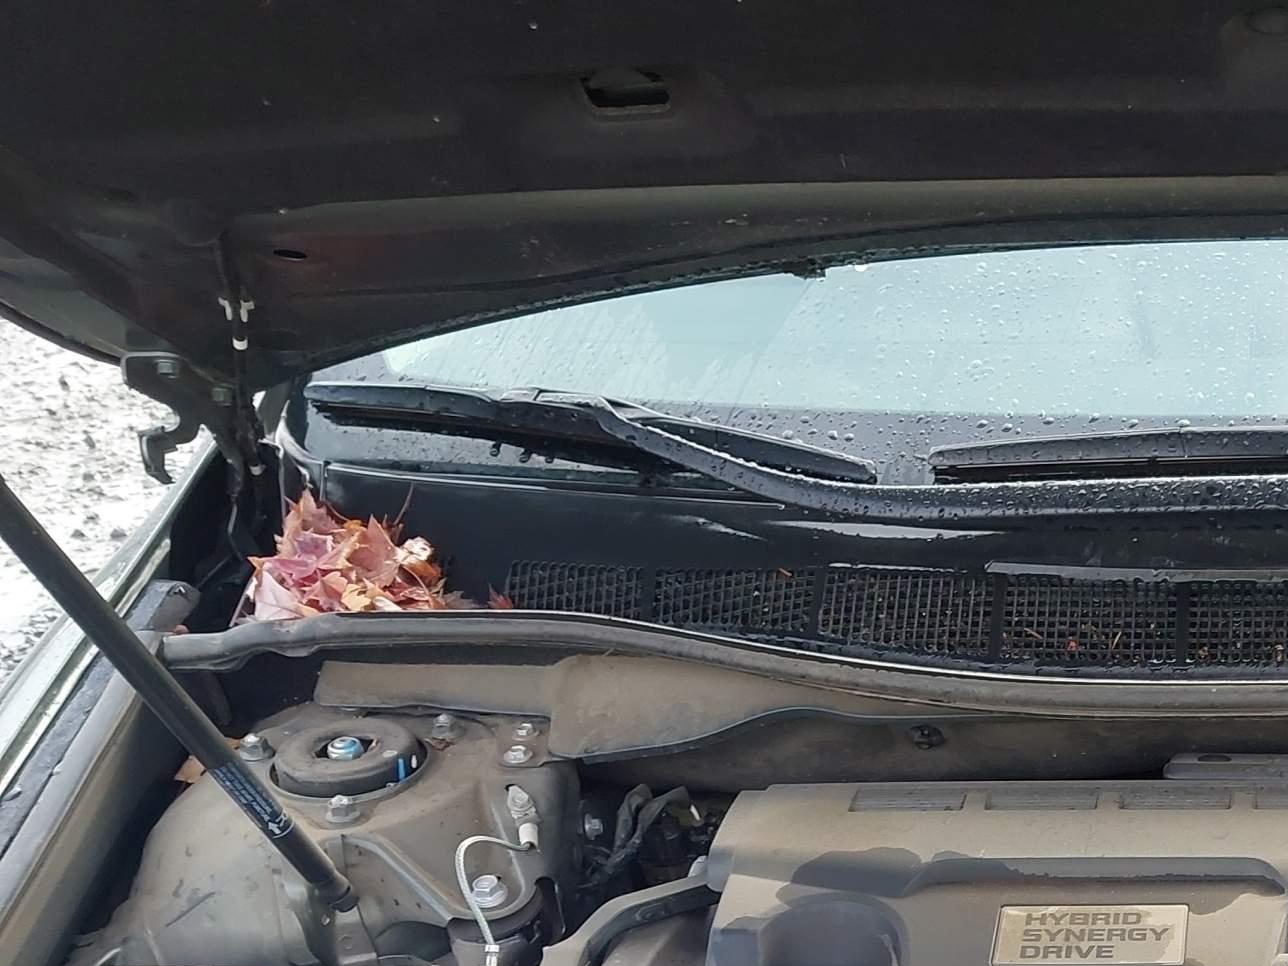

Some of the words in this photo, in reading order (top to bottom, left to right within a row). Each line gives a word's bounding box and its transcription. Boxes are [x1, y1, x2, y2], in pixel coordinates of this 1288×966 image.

[1025, 912, 1142, 926] HYBRID
[1021, 927, 1169, 942] SYNERGY
[1019, 944, 1115, 959] DRIVE
